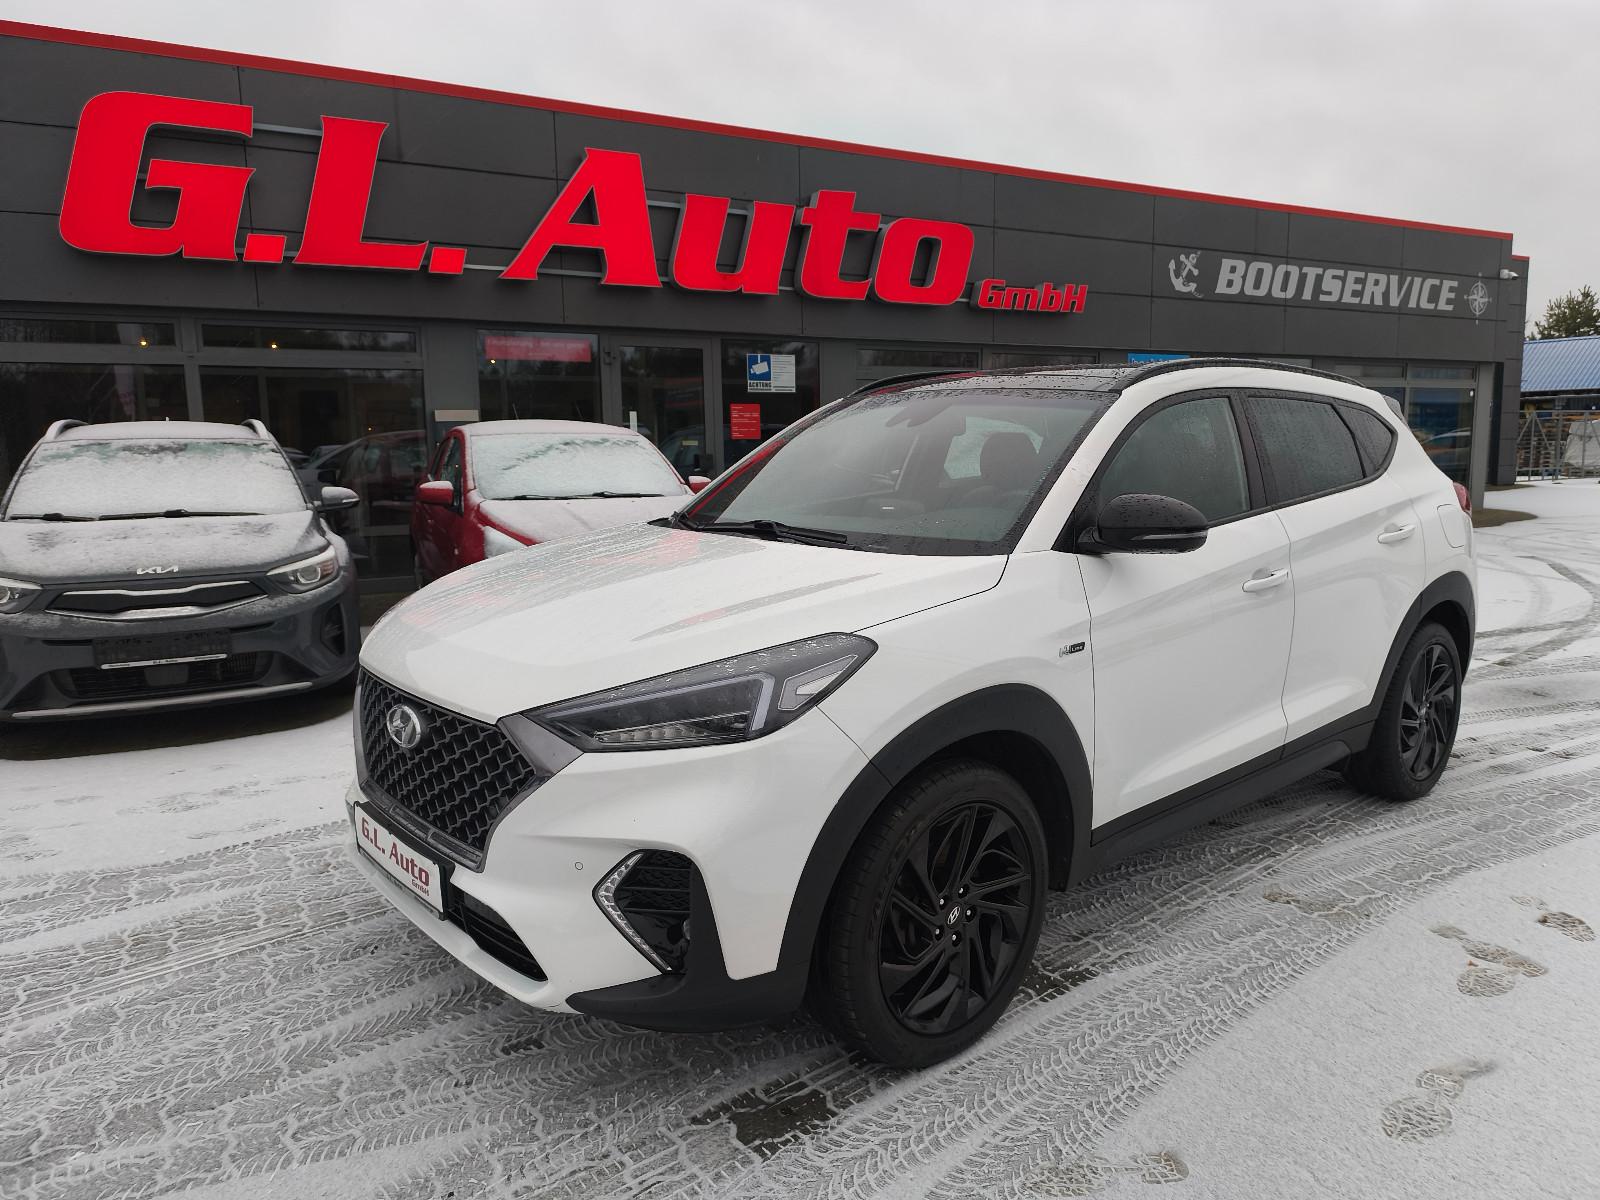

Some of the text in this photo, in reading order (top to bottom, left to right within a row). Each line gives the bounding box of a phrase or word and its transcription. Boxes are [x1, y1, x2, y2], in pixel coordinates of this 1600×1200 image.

[59, 91, 1088, 314] G.L. Auto GmbH
[1214, 258, 1459, 312] BOOTSERVICE
[361, 816, 430, 887] G.L. Auto
